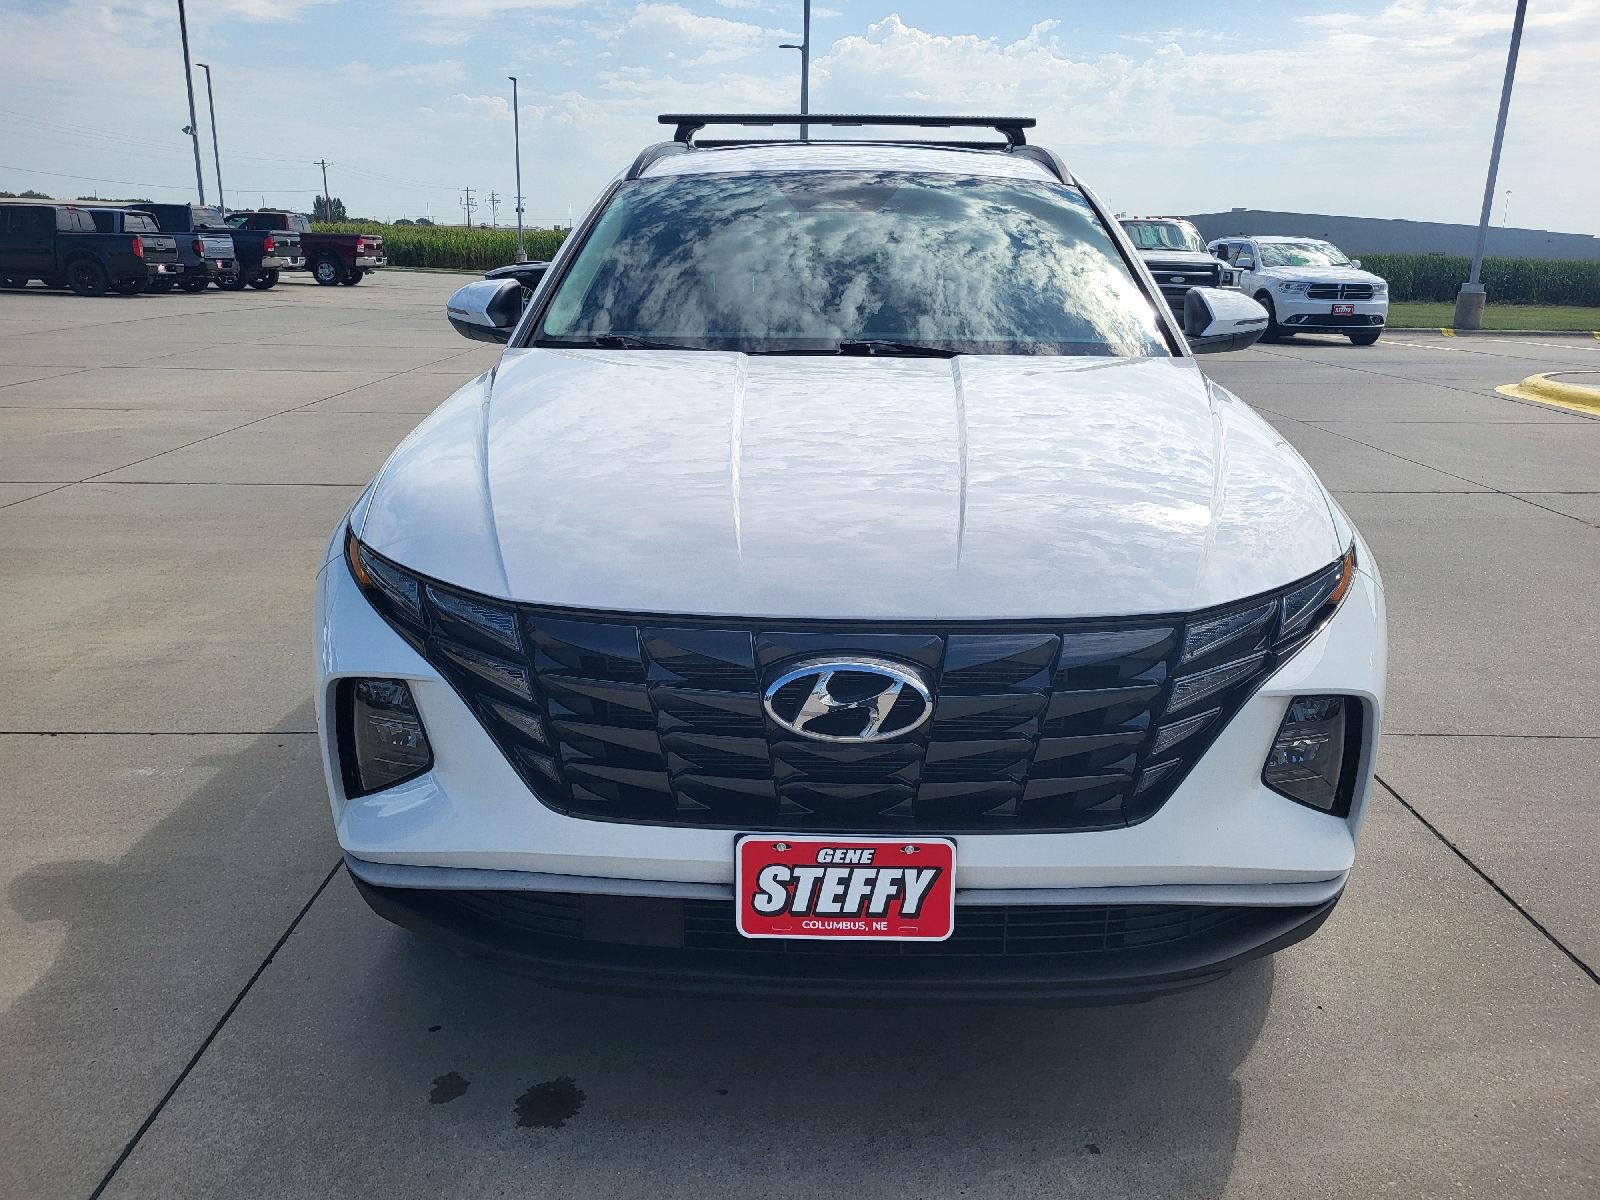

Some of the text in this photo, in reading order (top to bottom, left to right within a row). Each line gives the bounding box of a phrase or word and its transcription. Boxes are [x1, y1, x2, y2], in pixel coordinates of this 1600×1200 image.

[816, 848, 875, 865] GENE
[752, 864, 942, 918] STEFFY
[802, 920, 888, 931] COLUMBUS, NE
